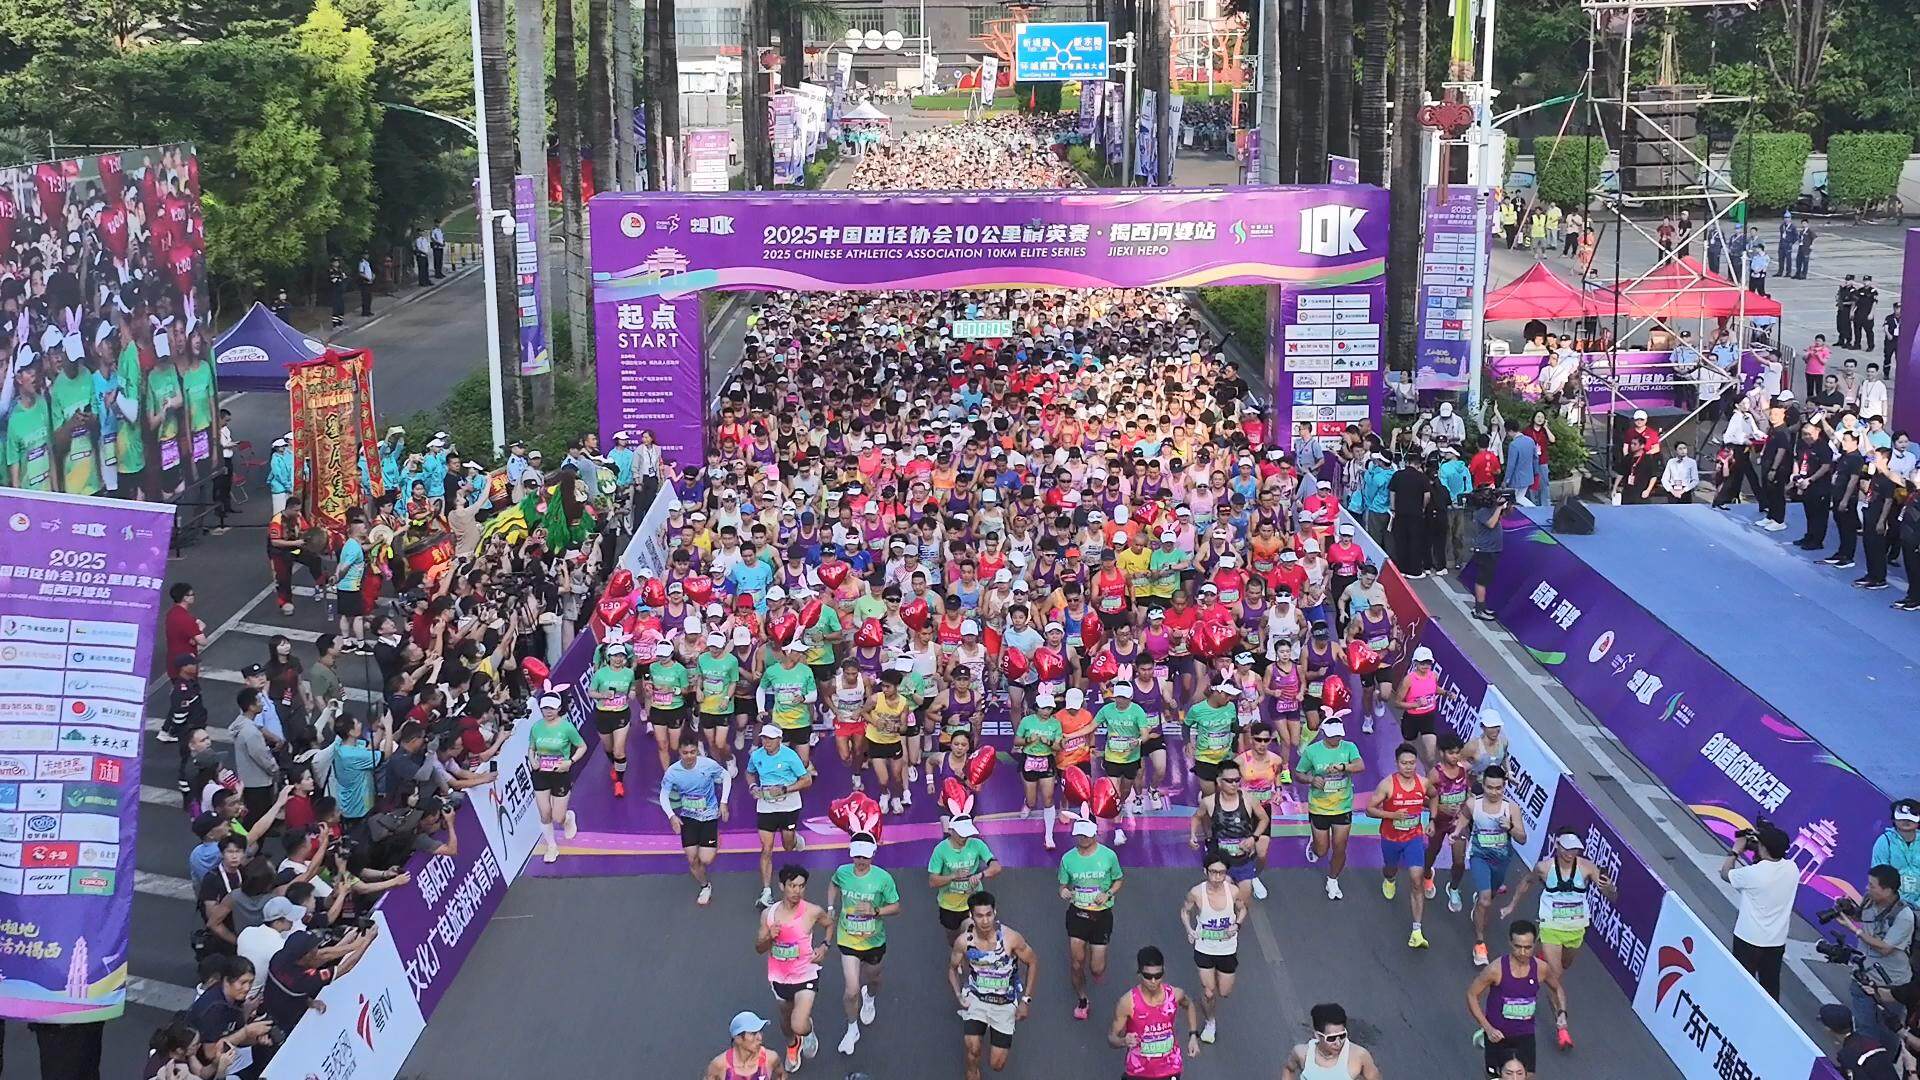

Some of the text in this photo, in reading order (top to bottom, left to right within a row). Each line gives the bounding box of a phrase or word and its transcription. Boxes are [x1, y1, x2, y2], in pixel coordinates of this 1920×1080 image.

[1451, 206, 1472, 214] 2025
[1299, 203, 1368, 257] 10K
[763, 245, 1169, 259] 2025 CHINESE ATHLETICS ASSOCIATION 10KM ELITE SERIES JIEXI HEPO
[618, 303, 677, 330] 起点
[618, 333, 678, 348] START
[49, 549, 107, 569] 2025
[600, 602, 621, 610] 1:30
[858, 623, 873, 641] 1:00
[1700, 732, 1792, 813] 创造你的纪录
[834, 801, 858, 819] 1:15
[947, 860, 976, 869] PACER
[1583, 823, 1623, 890] 揭阳市
[416, 853, 457, 911] 揭阳市
[1072, 871, 1106, 879] PACER
[403, 845, 501, 1002] 文化广电旅游体育局
